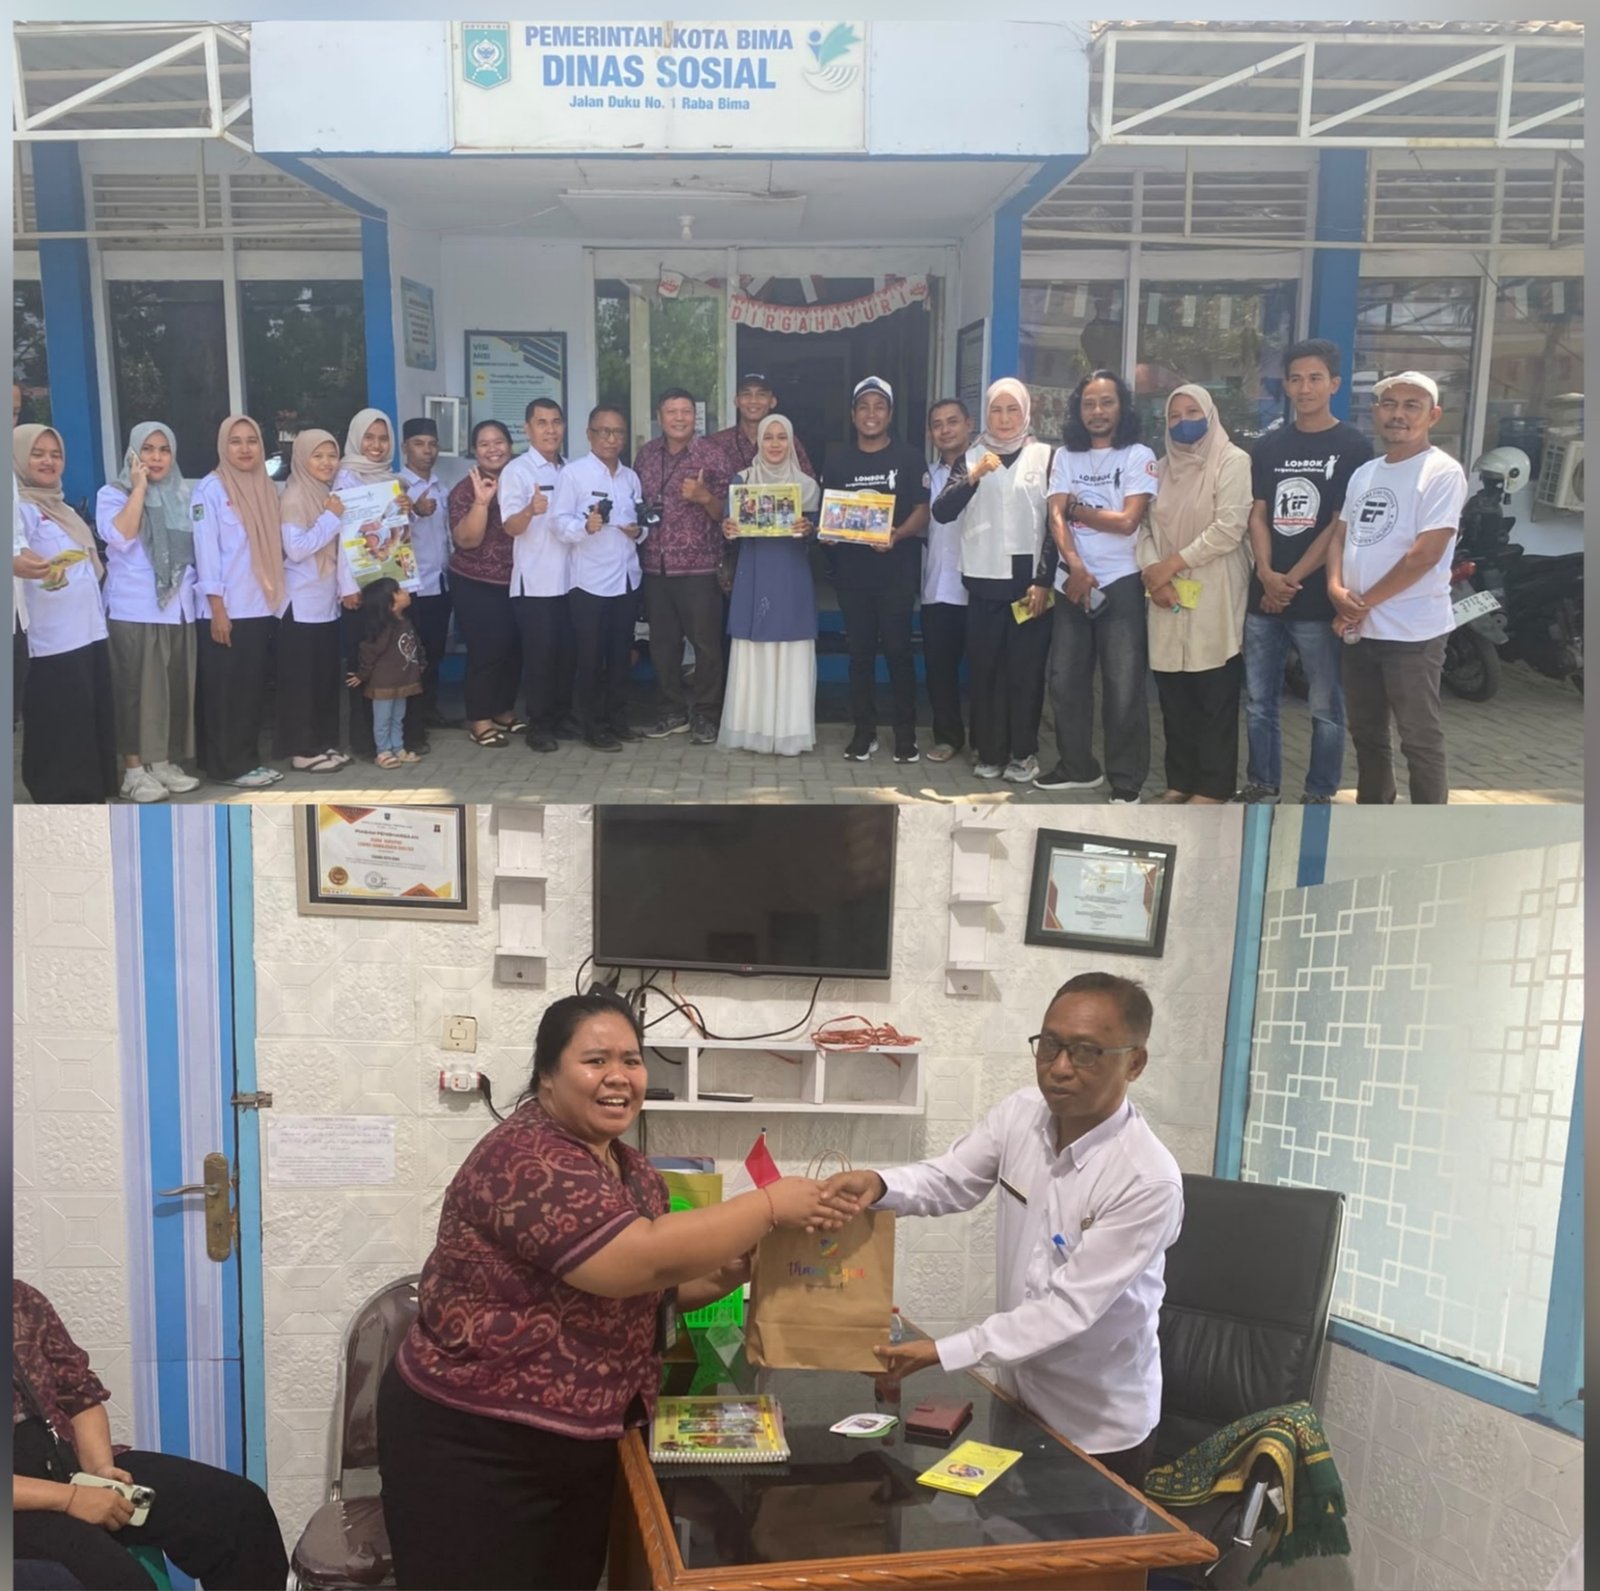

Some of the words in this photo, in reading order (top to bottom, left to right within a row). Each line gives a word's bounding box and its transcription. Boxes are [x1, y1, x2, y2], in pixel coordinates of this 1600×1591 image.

[525, 25, 662, 48] PEMERINTAH
[673, 27, 729, 50] KOTA
[736, 29, 794, 50] BIMA
[542, 54, 645, 87] DINAS
[656, 55, 776, 90] SOSIAL
[569, 95, 604, 110] Jalan
[608, 95, 642, 109] Duku
[645, 96, 665, 109] No.
[682, 97, 714, 110] Raba
[718, 97, 750, 110] Bima
